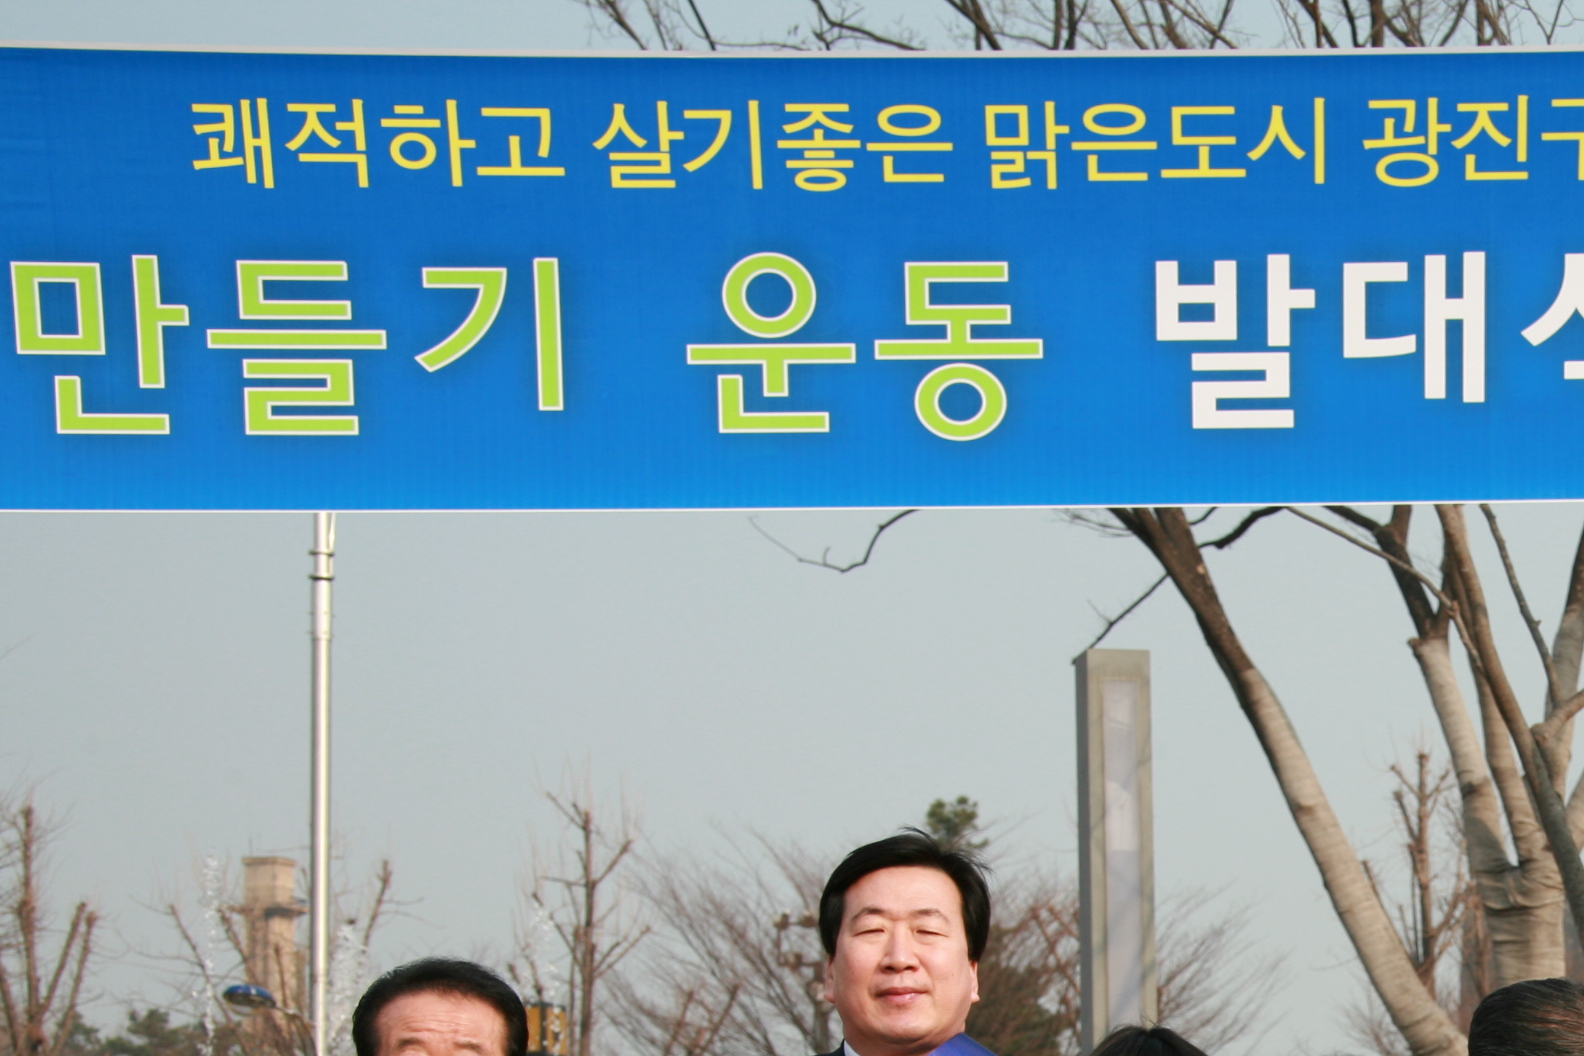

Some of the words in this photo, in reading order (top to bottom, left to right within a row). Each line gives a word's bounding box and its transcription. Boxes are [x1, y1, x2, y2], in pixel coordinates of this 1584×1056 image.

[192, 98, 564, 189] 쾌적하고
[593, 100, 952, 191] 살기좋은
[986, 98, 1325, 189] 맑은도시
[10, 255, 564, 436] 만들기
[687, 252, 1044, 441] 운동
